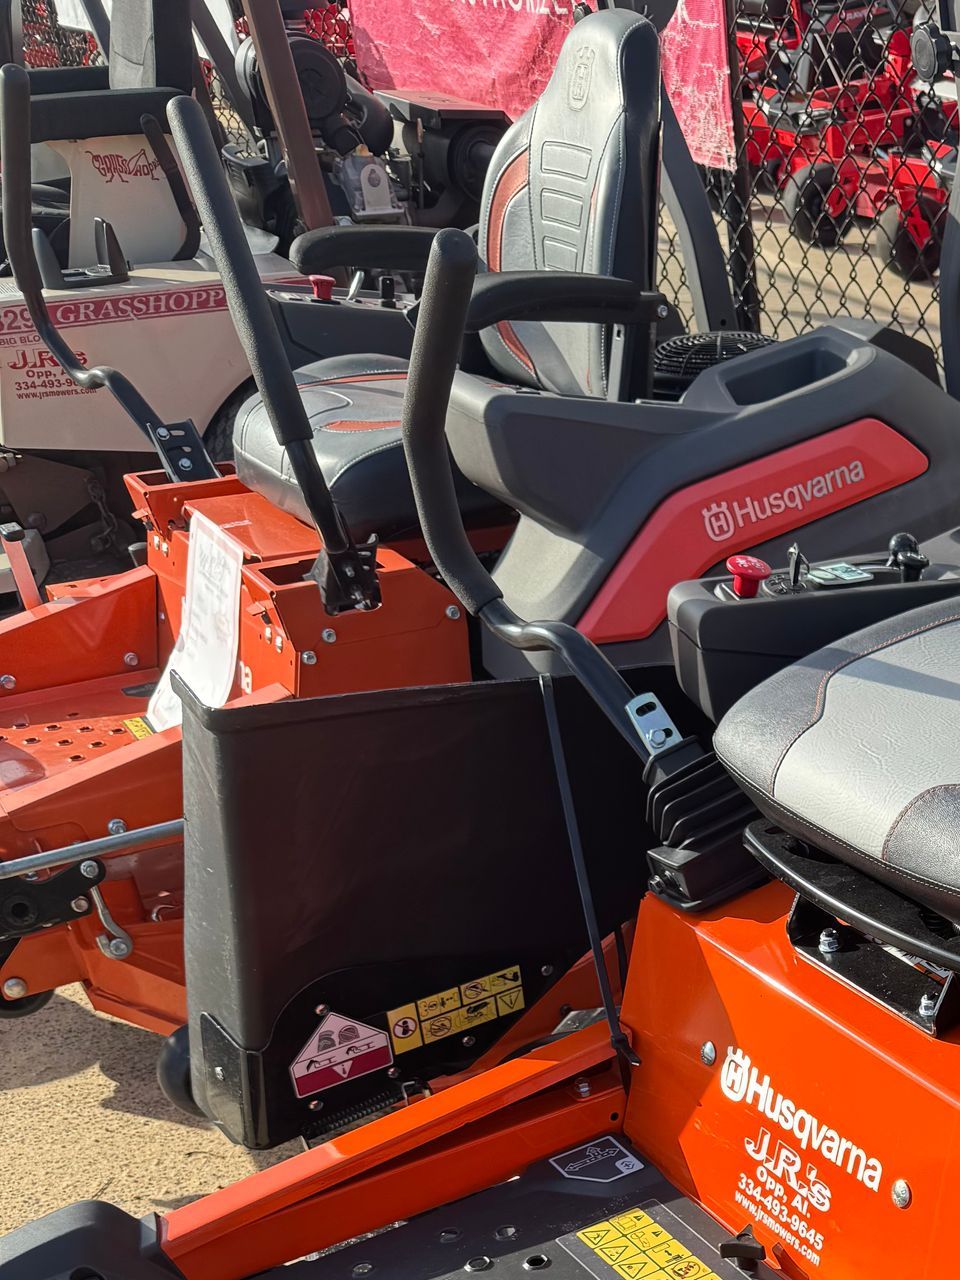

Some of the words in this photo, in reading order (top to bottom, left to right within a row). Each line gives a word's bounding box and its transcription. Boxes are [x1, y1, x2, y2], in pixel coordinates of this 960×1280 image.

[56, 288, 225, 323] GRASSHOPP
[732, 460, 865, 528] Husqvarna
[745, 1066, 882, 1192] Husqvarna
[738, 1173, 824, 1250] 334-493-9645
[756, 1165, 788, 1203] Opp,
[735, 1190, 821, 1267] www.jrsmowers.com
